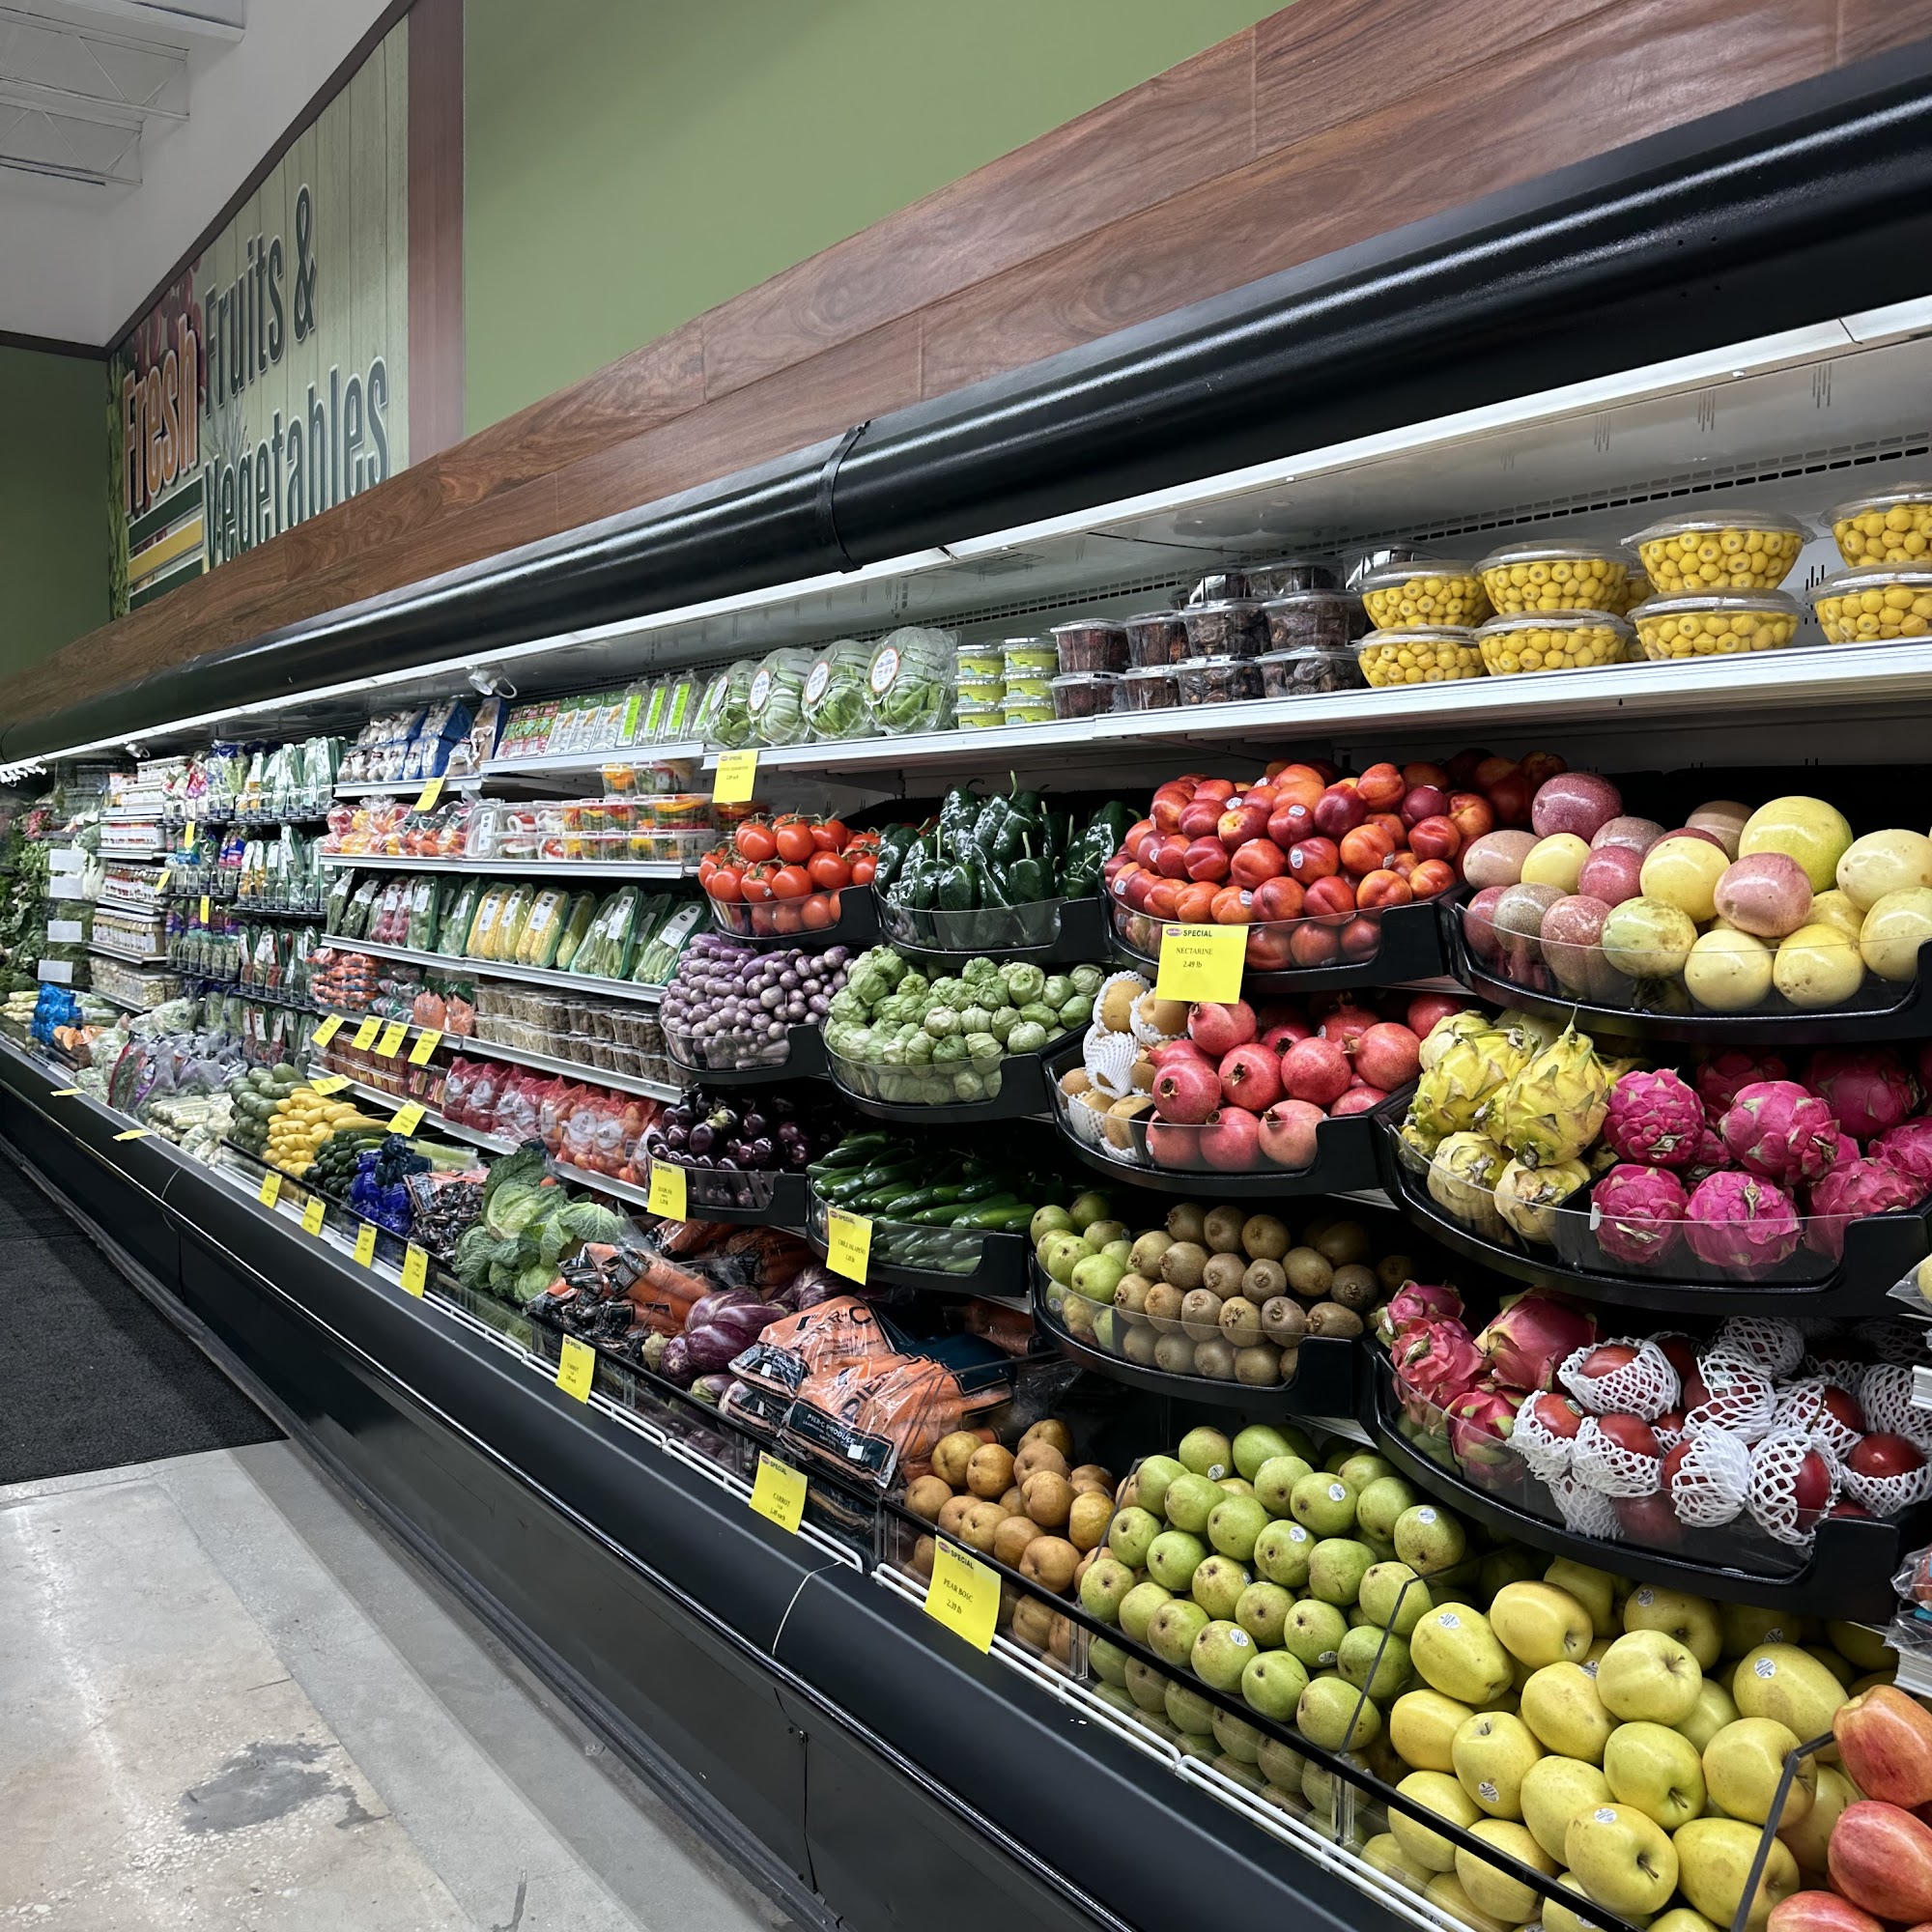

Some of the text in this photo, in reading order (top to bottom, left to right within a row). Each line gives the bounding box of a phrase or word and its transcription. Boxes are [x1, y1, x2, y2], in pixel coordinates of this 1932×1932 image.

[205, 183, 317, 419] Fruits &
[123, 312, 200, 516] Fresh
[204, 355, 390, 568] Vegetables
[1176, 947, 1213, 955] NECTARINE
[807, 1413, 826, 1429] PIER-C
[825, 1423, 857, 1445] PRODUCE
[769, 1461, 787, 1476] SPECIAL
[773, 1492, 791, 1507] CARROT
[951, 1549, 974, 1570] SPECIAL
[943, 1578, 974, 1603] PEAR BOSC
